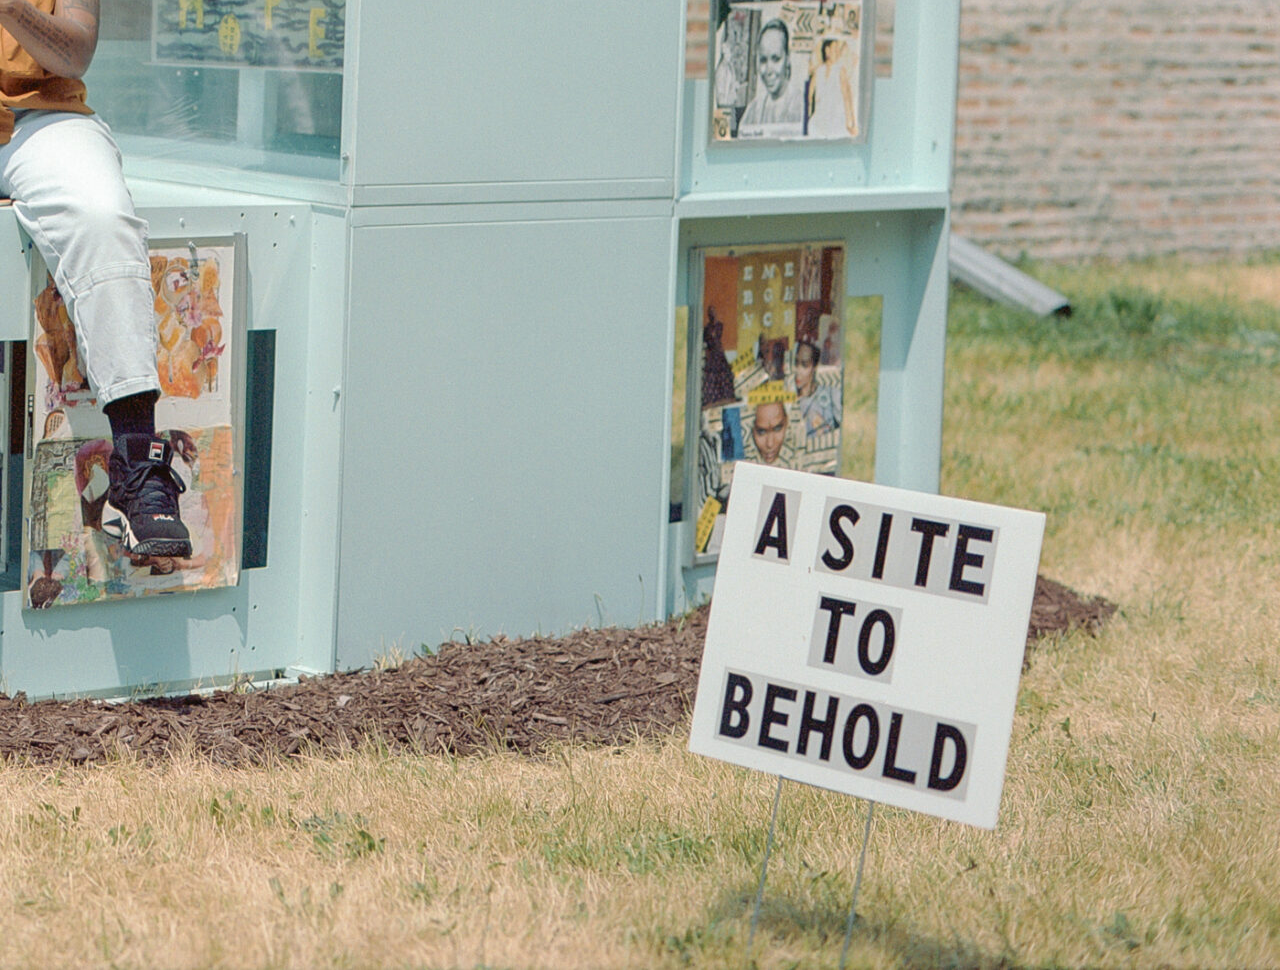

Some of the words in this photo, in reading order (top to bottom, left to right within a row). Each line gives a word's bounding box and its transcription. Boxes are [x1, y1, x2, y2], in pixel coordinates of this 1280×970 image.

[754, 492, 788, 560] A
[821, 504, 994, 596] SITE
[820, 596, 896, 676] TO
[719, 672, 968, 792] BEHOLD
